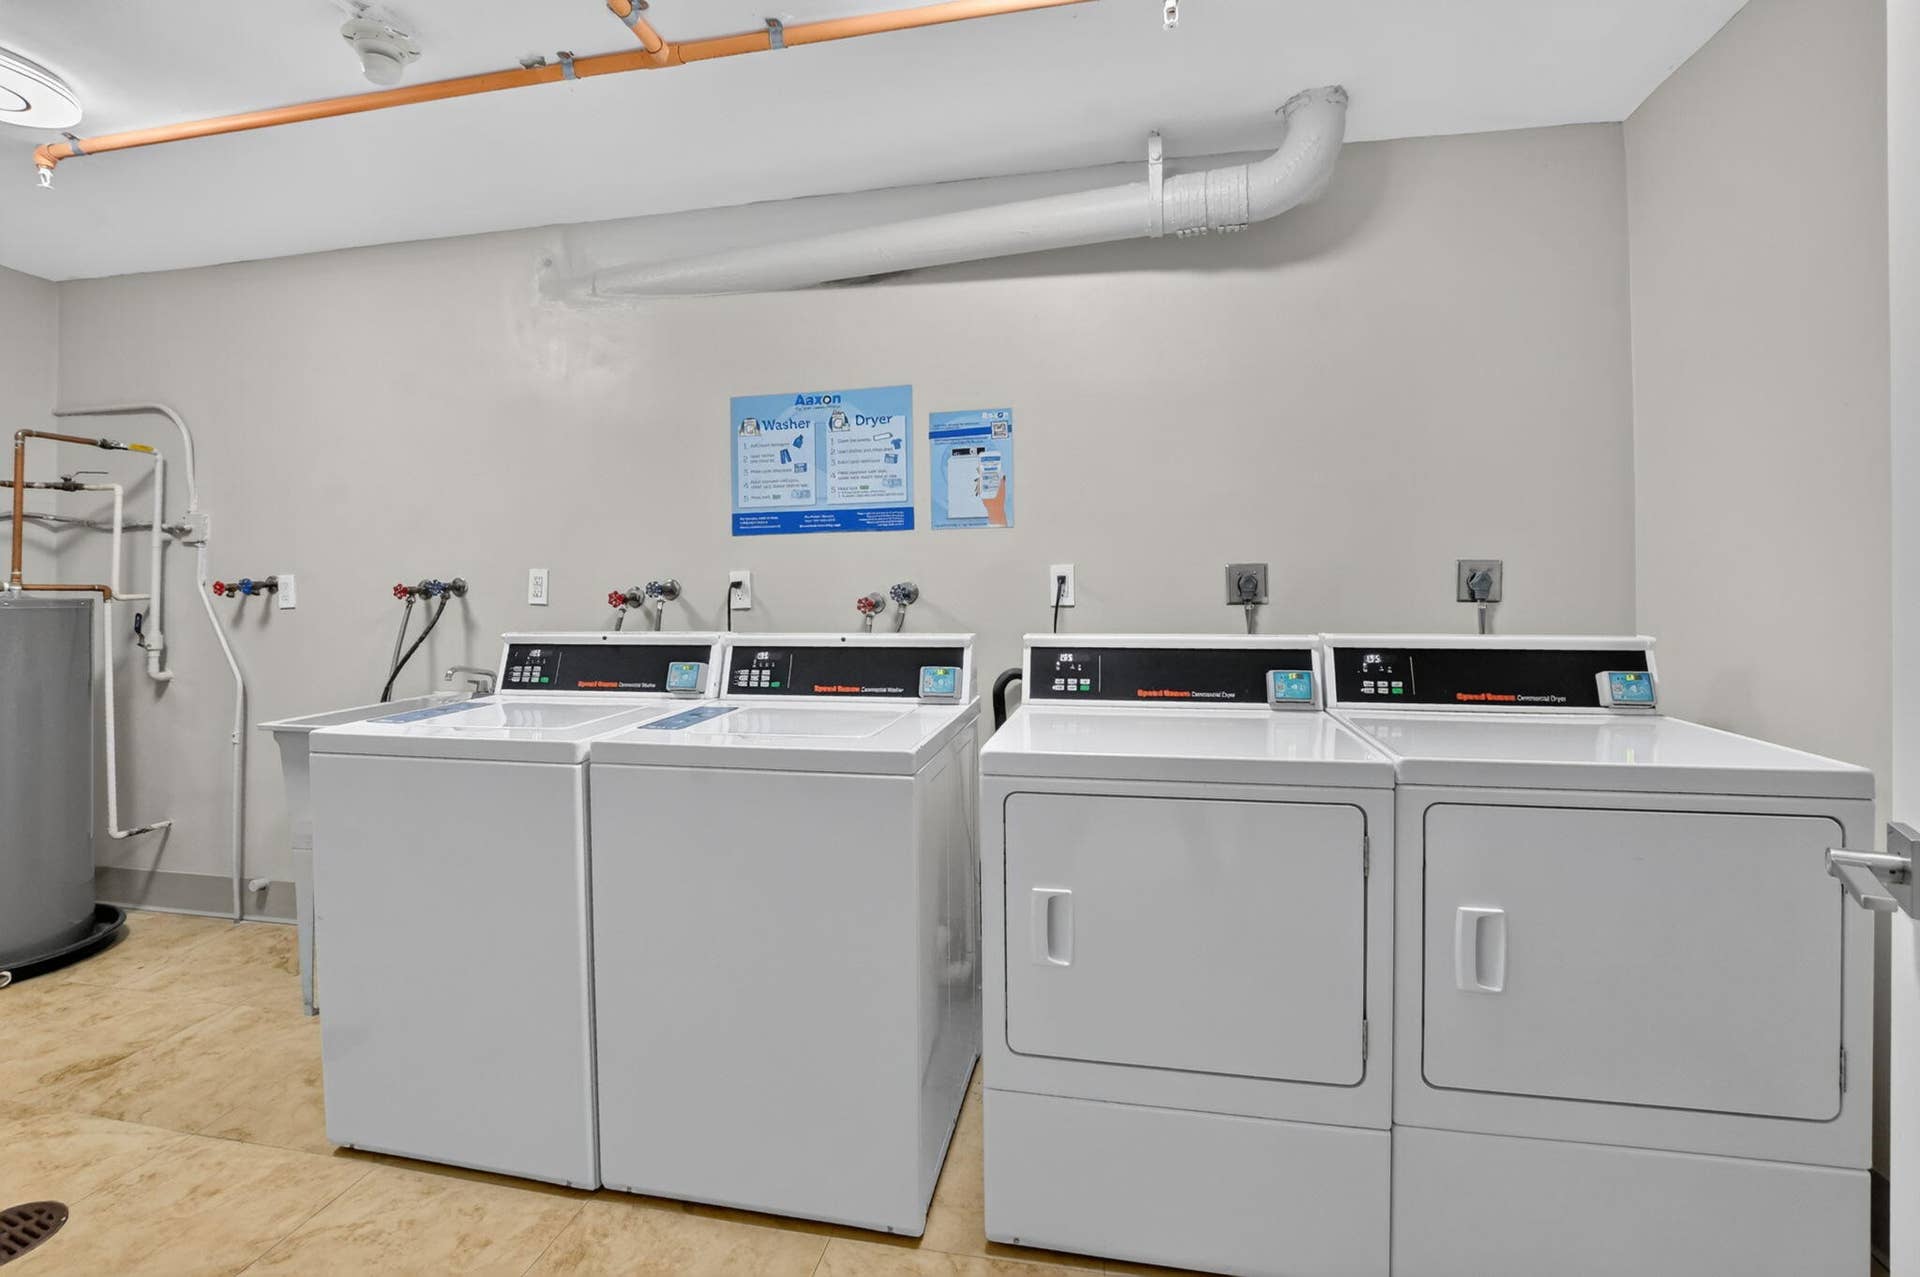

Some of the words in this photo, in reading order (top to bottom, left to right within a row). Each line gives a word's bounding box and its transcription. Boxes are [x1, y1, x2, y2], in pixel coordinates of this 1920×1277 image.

[795, 394, 841, 406] Aaxon
[762, 417, 811, 431] Washer
[855, 414, 893, 428] Dryer
